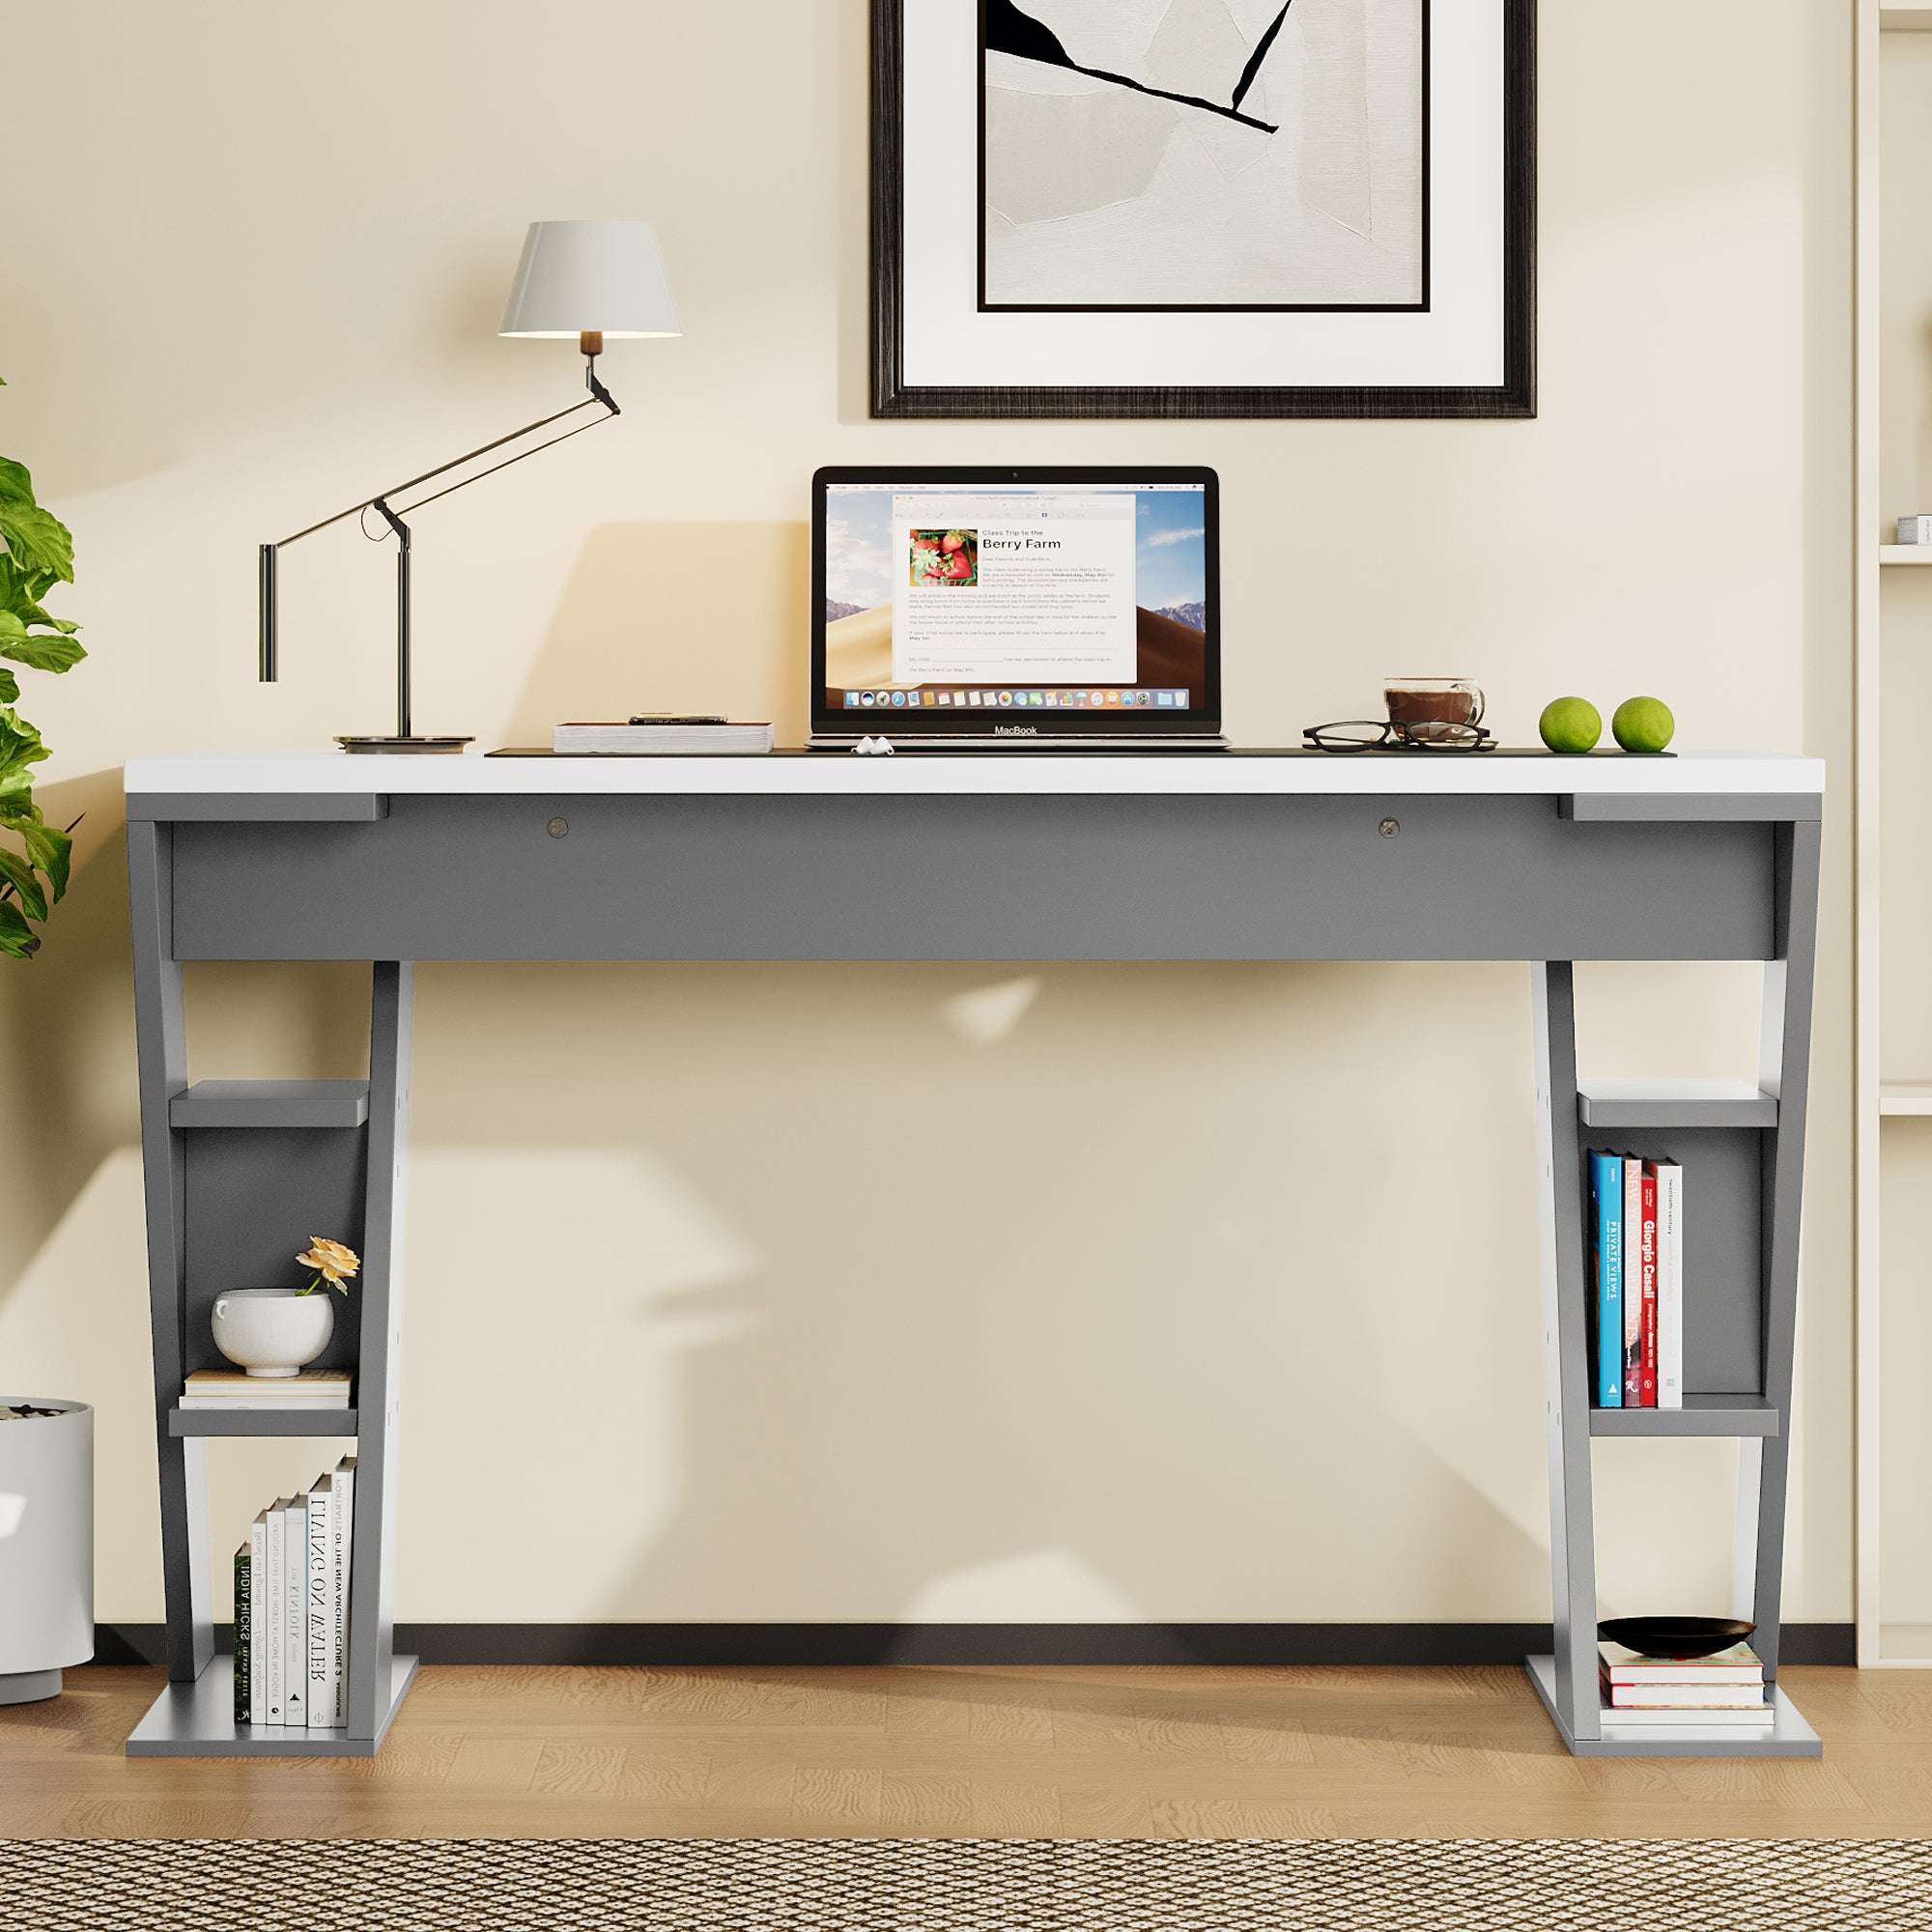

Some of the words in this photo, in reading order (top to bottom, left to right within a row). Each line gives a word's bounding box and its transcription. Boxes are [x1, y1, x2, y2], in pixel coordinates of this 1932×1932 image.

[982, 539, 1022, 551] Berry
[1026, 539, 1061, 549] Farm
[995, 726, 1037, 735] MacBook
[1627, 1169, 1638, 1201] NEW
[1627, 1206, 1638, 1247] YORK
[1642, 1220, 1655, 1262] Giorgio
[1627, 1249, 1638, 1342] APARTMENTS
[1644, 1264, 1655, 1298] Casali
